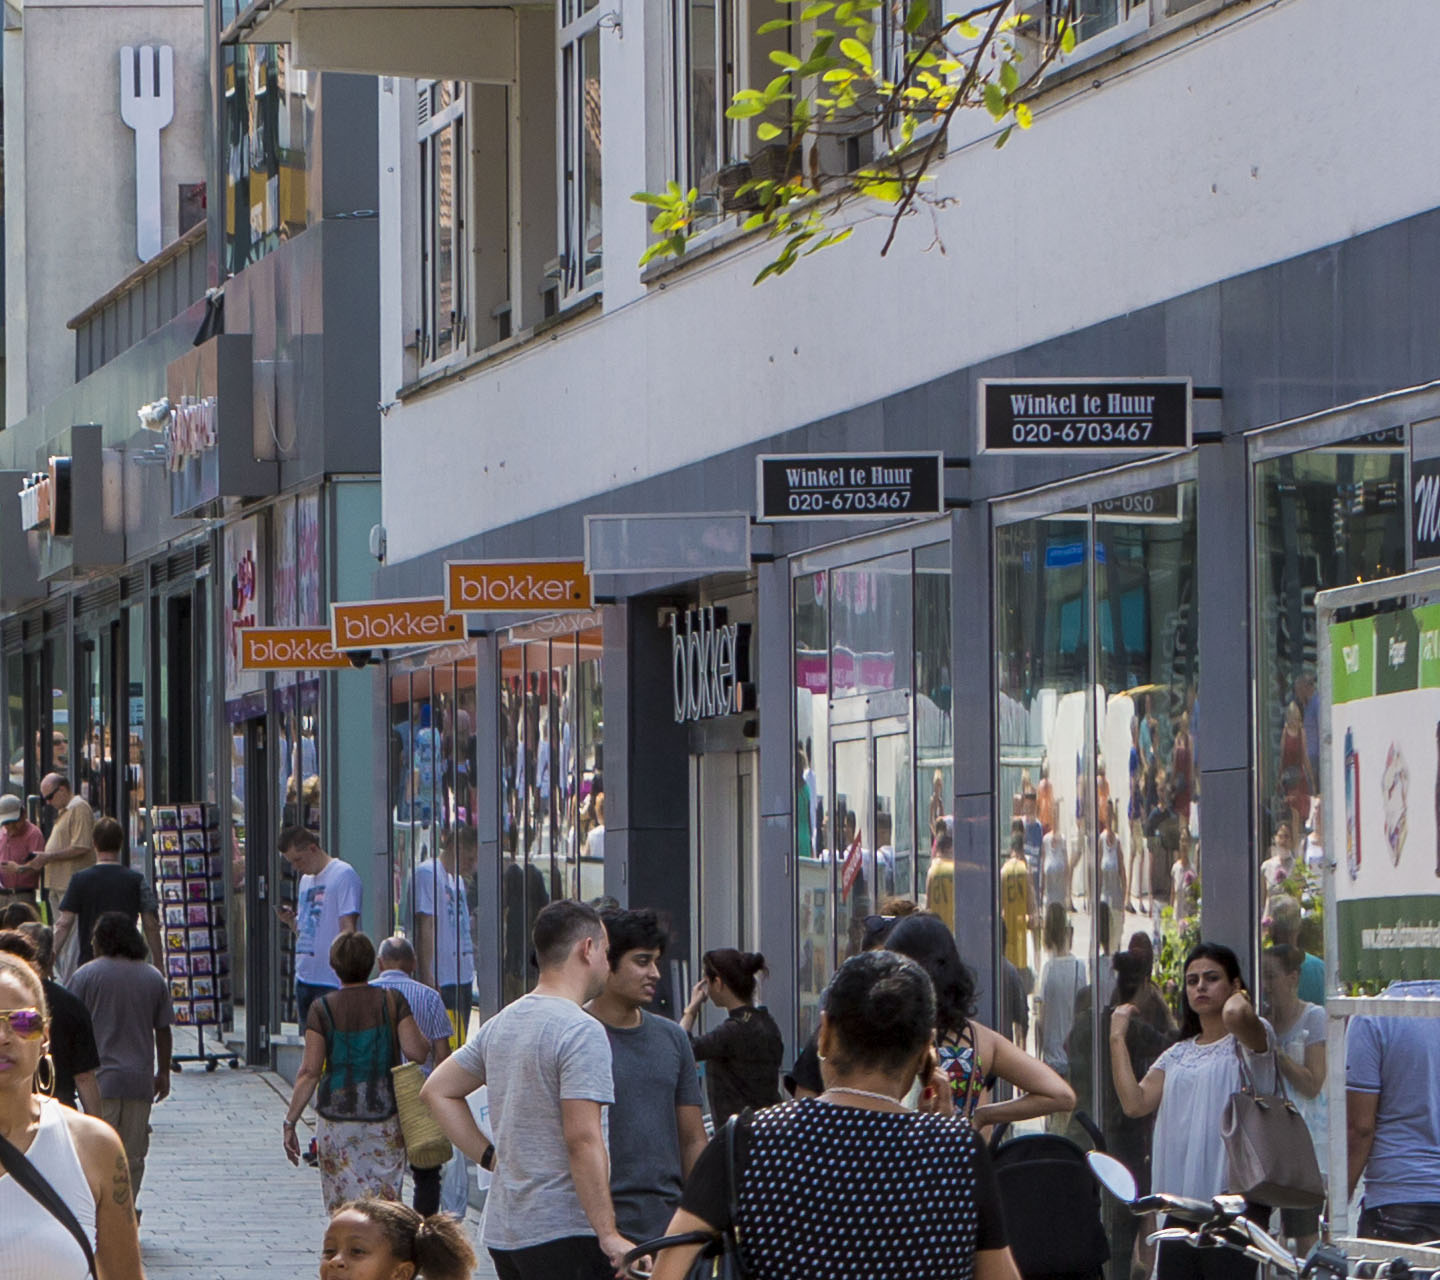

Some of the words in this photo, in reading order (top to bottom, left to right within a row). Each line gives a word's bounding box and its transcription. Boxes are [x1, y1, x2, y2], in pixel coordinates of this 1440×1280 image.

[1011, 394, 1076, 416] Winkel
[1082, 393, 1102, 415] te
[1107, 392, 1156, 415] Huur
[1012, 422, 1153, 442] 020-6703467
[786, 468, 846, 488] Winkel
[849, 467, 867, 486] te
[870, 466, 913, 486] Huur
[789, 491, 912, 511] 020-6703467
